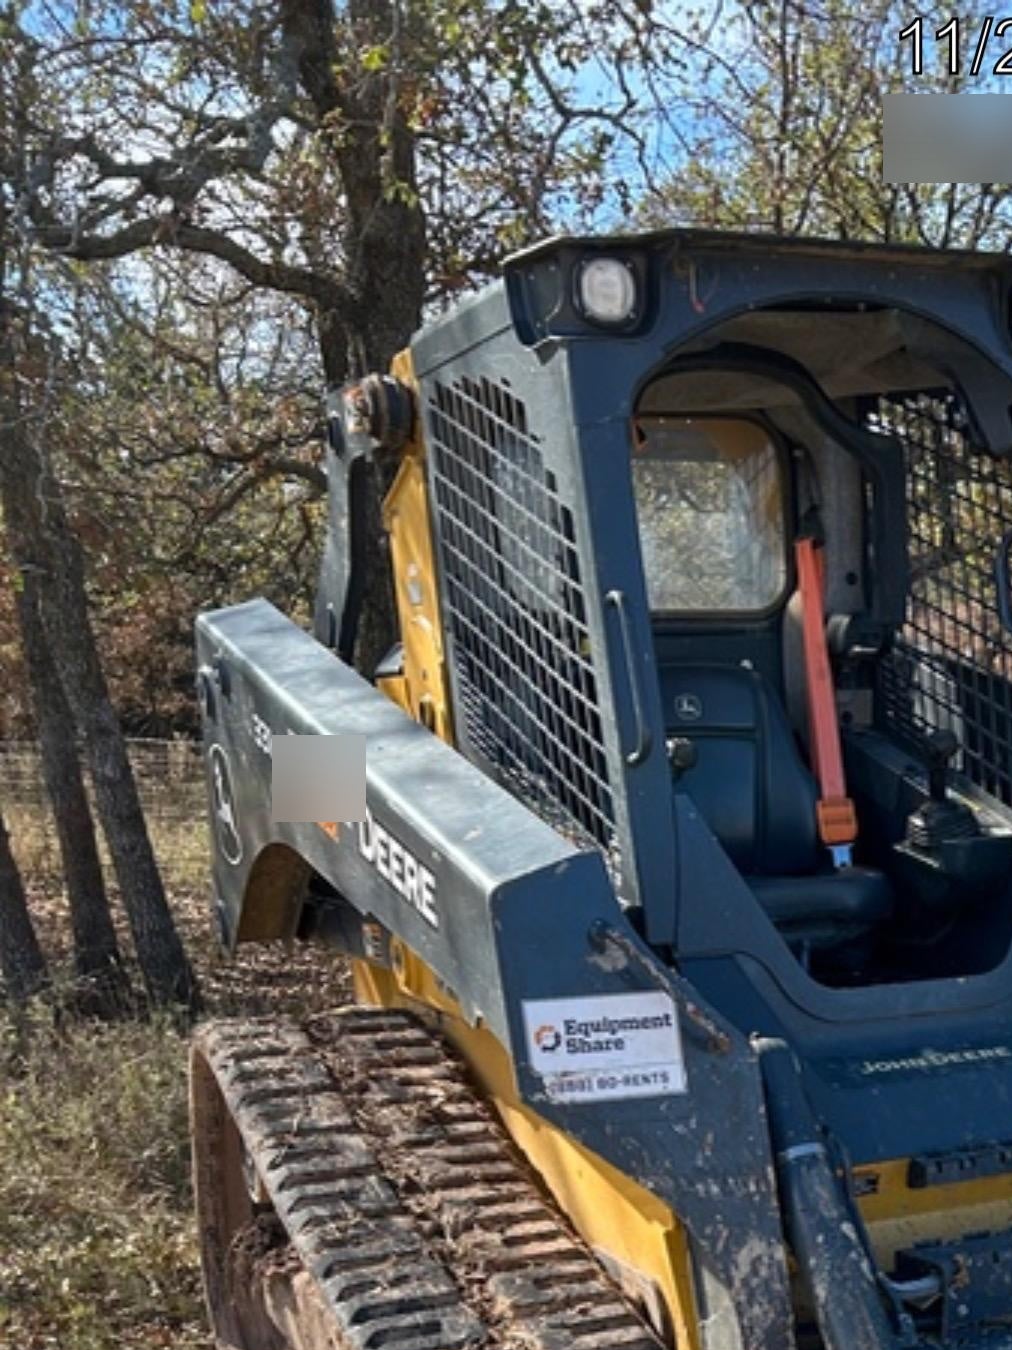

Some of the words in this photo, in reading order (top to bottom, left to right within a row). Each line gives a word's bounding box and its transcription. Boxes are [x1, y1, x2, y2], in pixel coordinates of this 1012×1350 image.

[358, 808, 439, 928] DEERE
[564, 1013, 672, 1037] Equipment
[566, 1037, 624, 1054] Share
